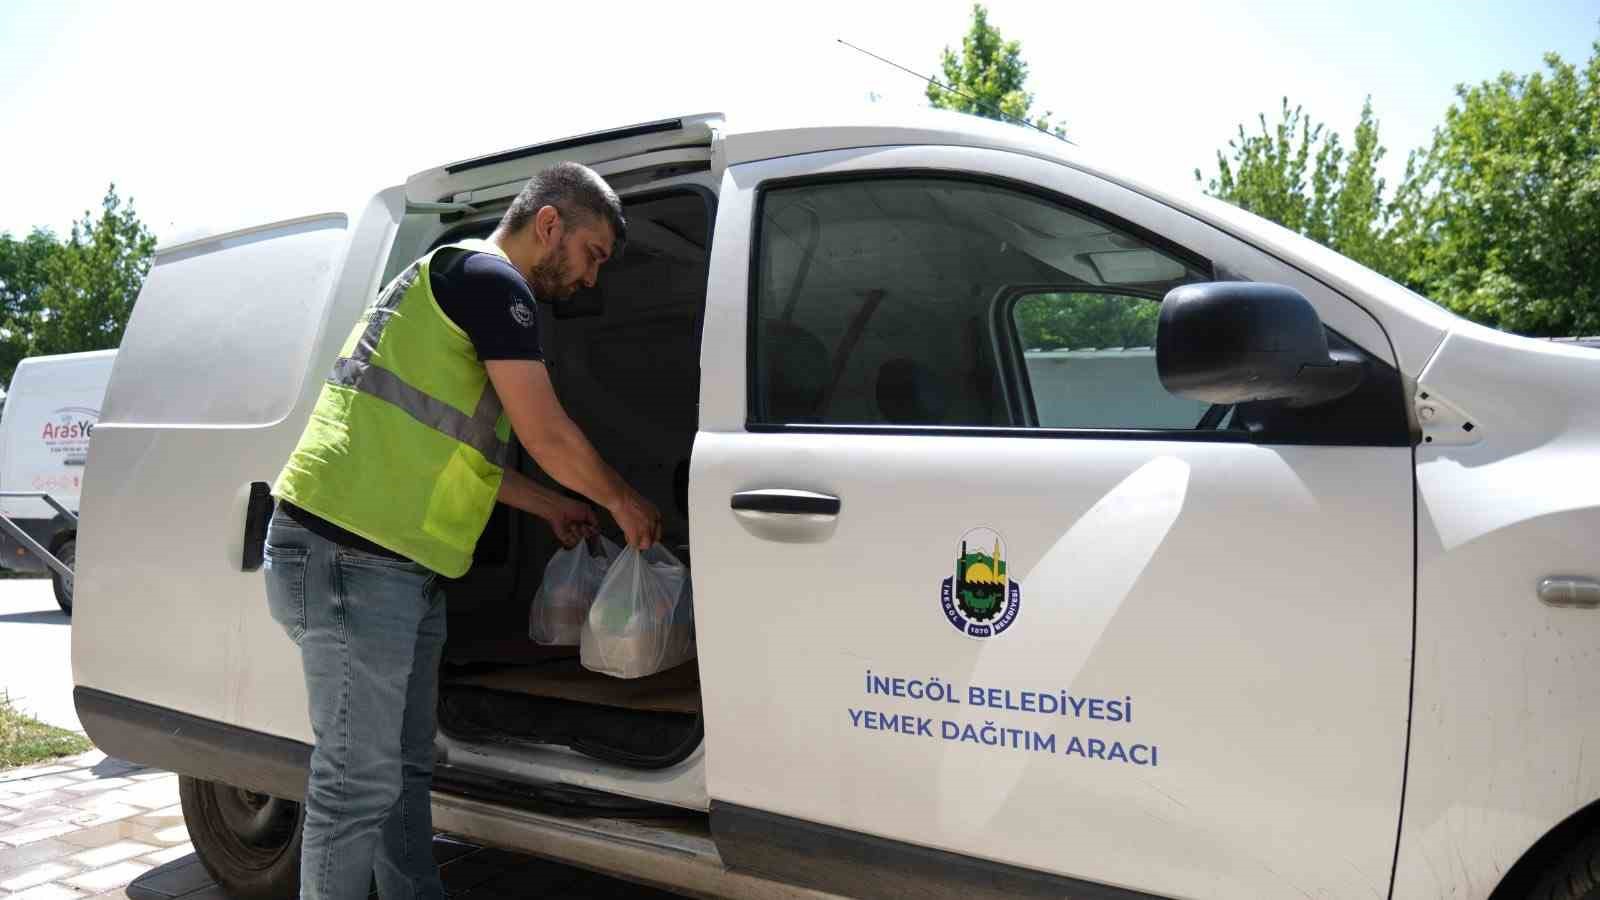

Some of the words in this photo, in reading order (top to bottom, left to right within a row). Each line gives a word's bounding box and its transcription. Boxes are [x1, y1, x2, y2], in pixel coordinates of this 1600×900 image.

[866, 670, 960, 704] İNEGÖL
[968, 686, 1131, 723] BELEDİYESİ
[848, 708, 933, 738] YEMEK
[942, 721, 1056, 754] DAĞITIM
[1065, 737, 1158, 766] ARACI
